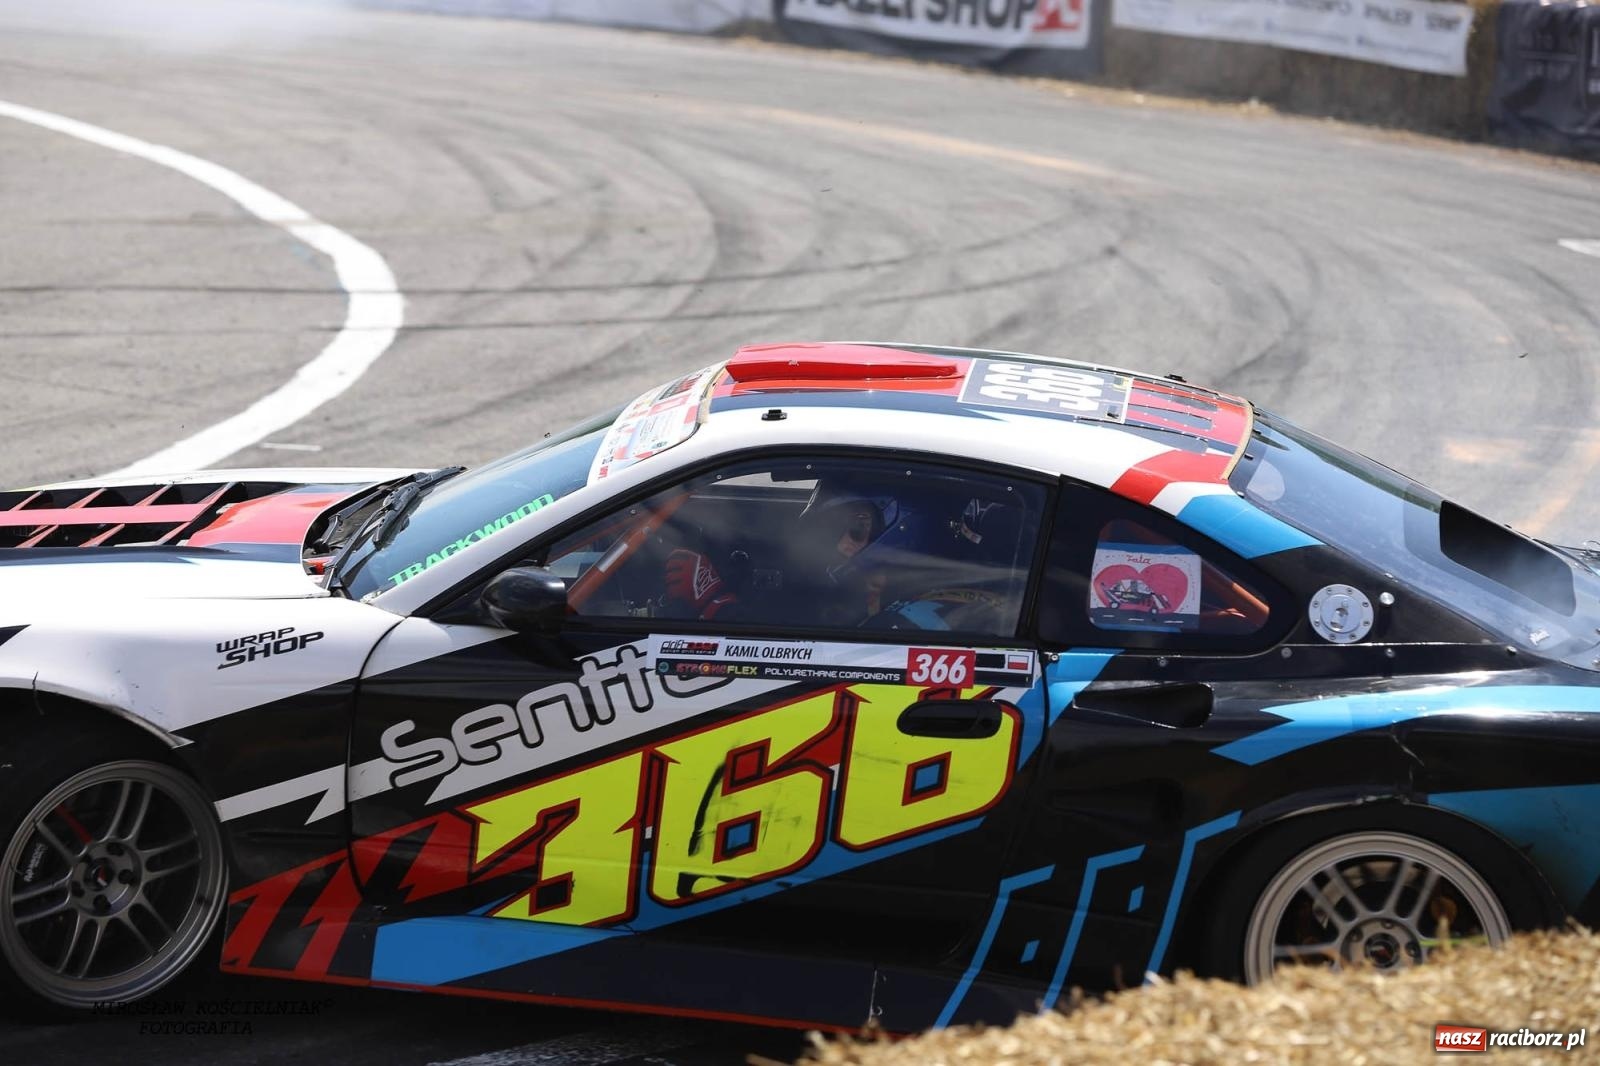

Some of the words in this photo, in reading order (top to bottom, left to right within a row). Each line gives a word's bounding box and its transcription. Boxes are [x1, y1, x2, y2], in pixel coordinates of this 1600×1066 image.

[979, 362, 1105, 411] 366
[387, 493, 555, 586] TRACKWOOD
[216, 626, 296, 654] WRAP
[217, 631, 325, 671] SHOP
[724, 644, 759, 658] KAMIL
[761, 646, 813, 660] OLBRYCH
[764, 667, 837, 679] POLYURETHANE
[838, 670, 901, 681] COMPONENTS
[911, 653, 968, 685] 366
[462, 683, 1020, 928] 366
